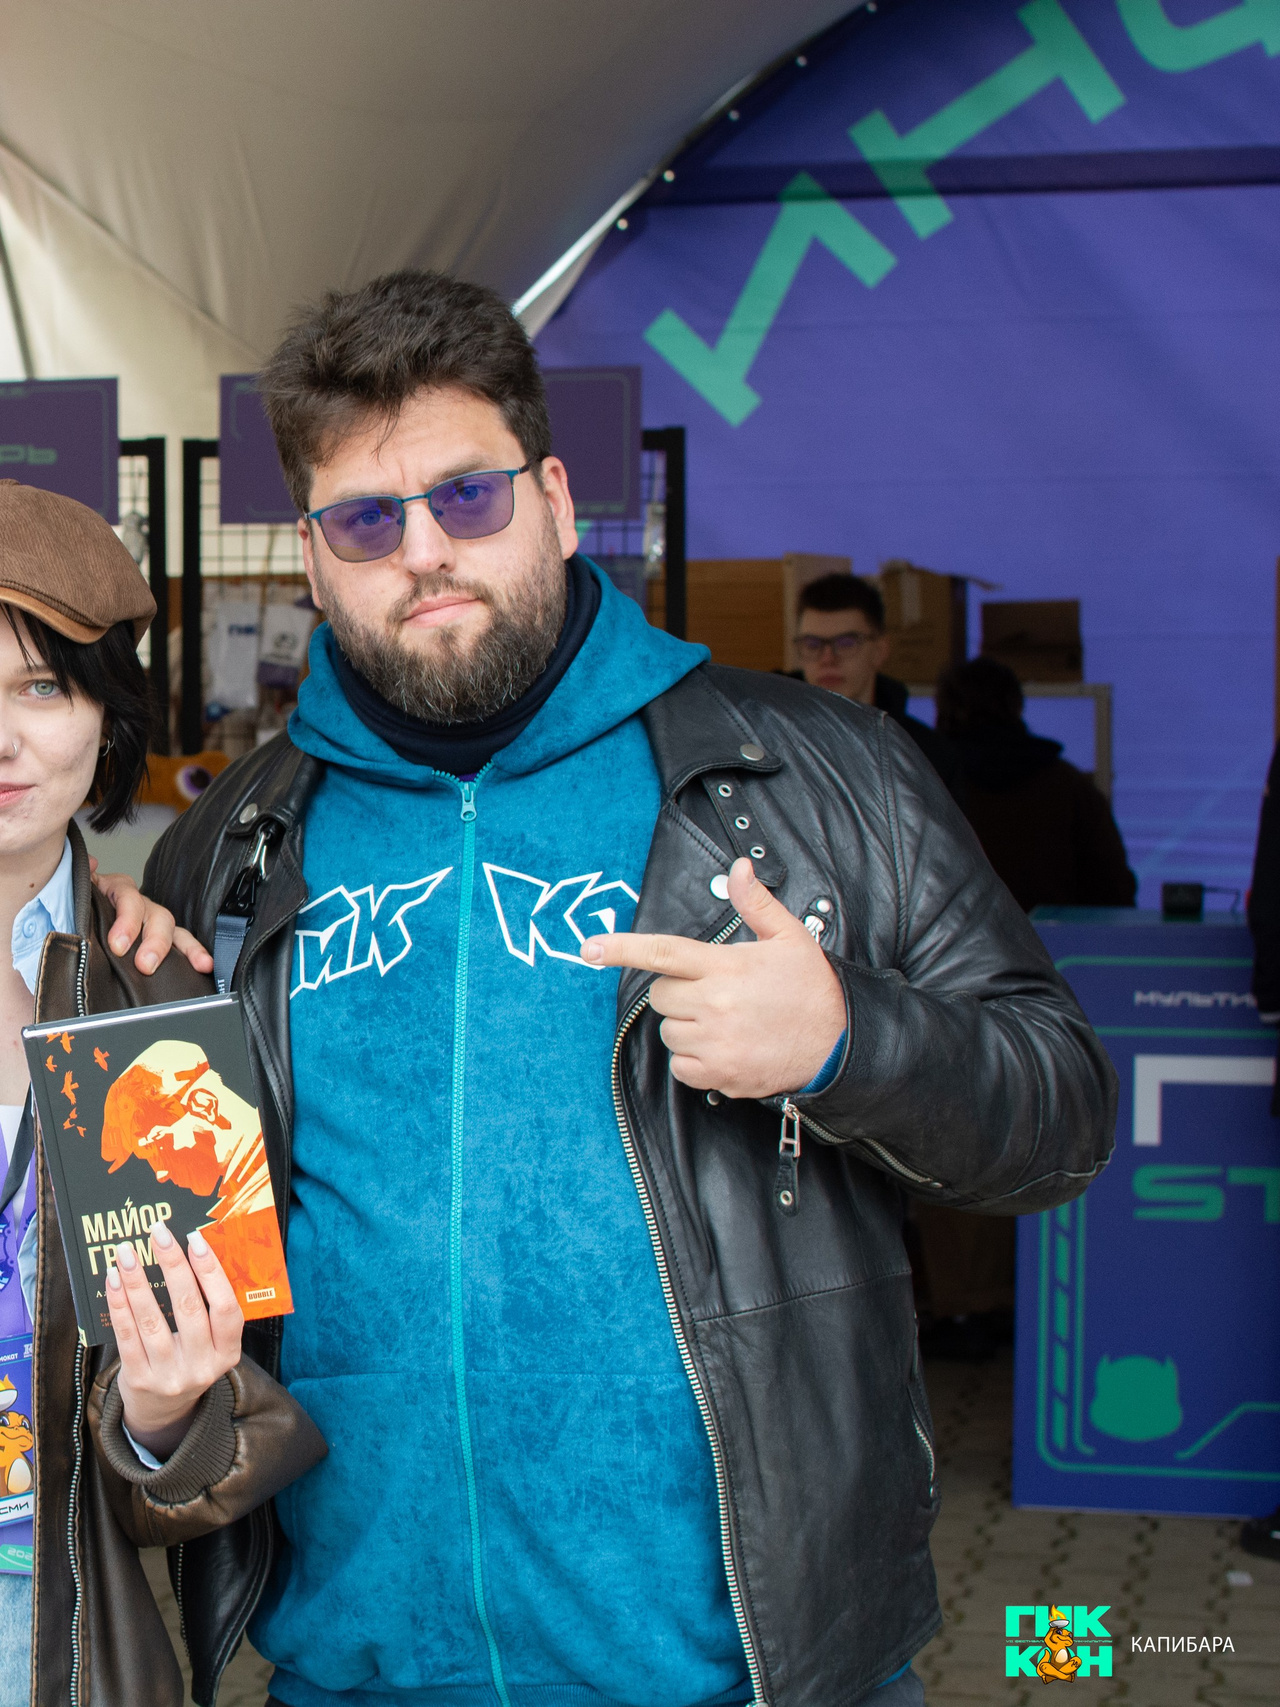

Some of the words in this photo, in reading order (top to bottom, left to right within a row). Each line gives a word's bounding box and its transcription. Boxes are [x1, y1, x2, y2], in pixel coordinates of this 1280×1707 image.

[81, 1197, 173, 1244] МАЙОР
[87, 1237, 161, 1276] ГРМ
[248, 1290, 274, 1300] BUBBLE
